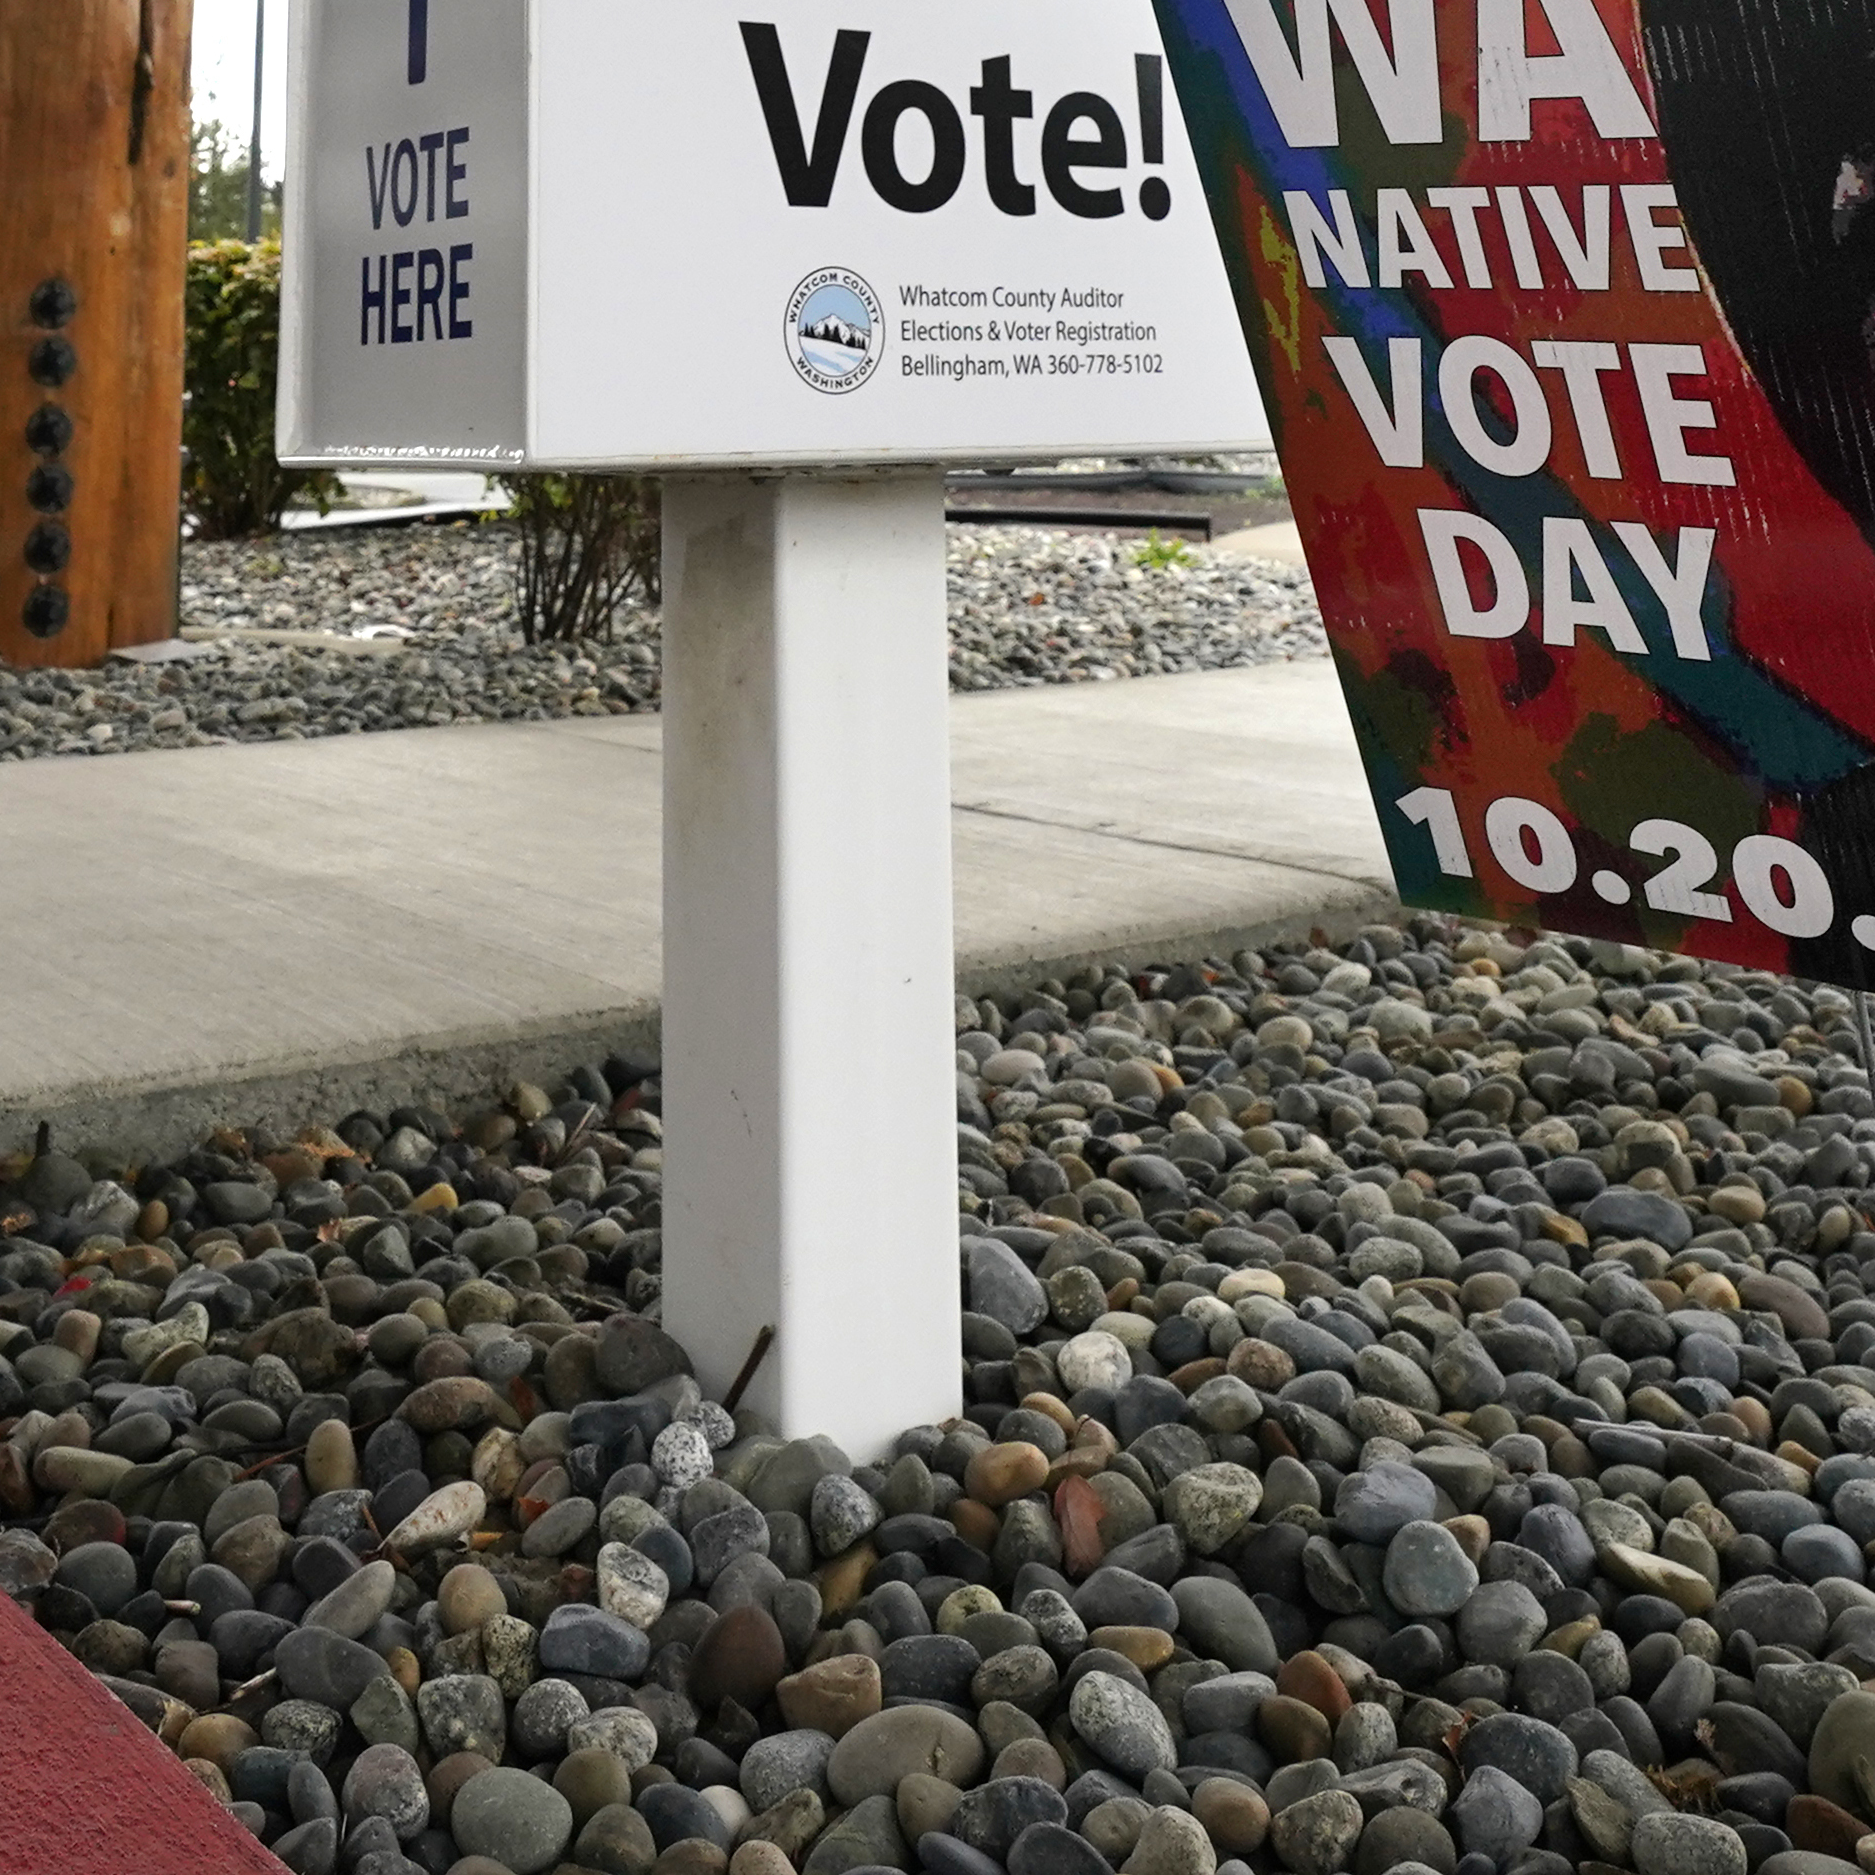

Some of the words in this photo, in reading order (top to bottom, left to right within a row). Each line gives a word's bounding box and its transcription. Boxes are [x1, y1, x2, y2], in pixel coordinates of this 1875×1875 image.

[737, 19, 1172, 222] Vote!
[365, 126, 470, 231] VOTE
[1281, 182, 1704, 294] NATIVE
[360, 242, 474, 347] HERE
[788, 272, 839, 324] WHATCOM
[842, 275, 881, 325] COUNTY
[898, 285, 988, 308] Whatcom
[992, 286, 1056, 313] County
[1060, 287, 1125, 309] Auditor
[900, 320, 983, 342] Elections
[987, 320, 1001, 342] &
[1003, 320, 1052, 342] Voter
[1055, 320, 1157, 347] Registration
[796, 355, 874, 390] WASHINGTON
[901, 354, 1010, 382] Bellingham,
[1013, 354, 1044, 375] WA
[1047, 353, 1164, 375] 360-778-5102
[1320, 334, 1738, 489] VOTE
[1416, 506, 1719, 663] DAY
